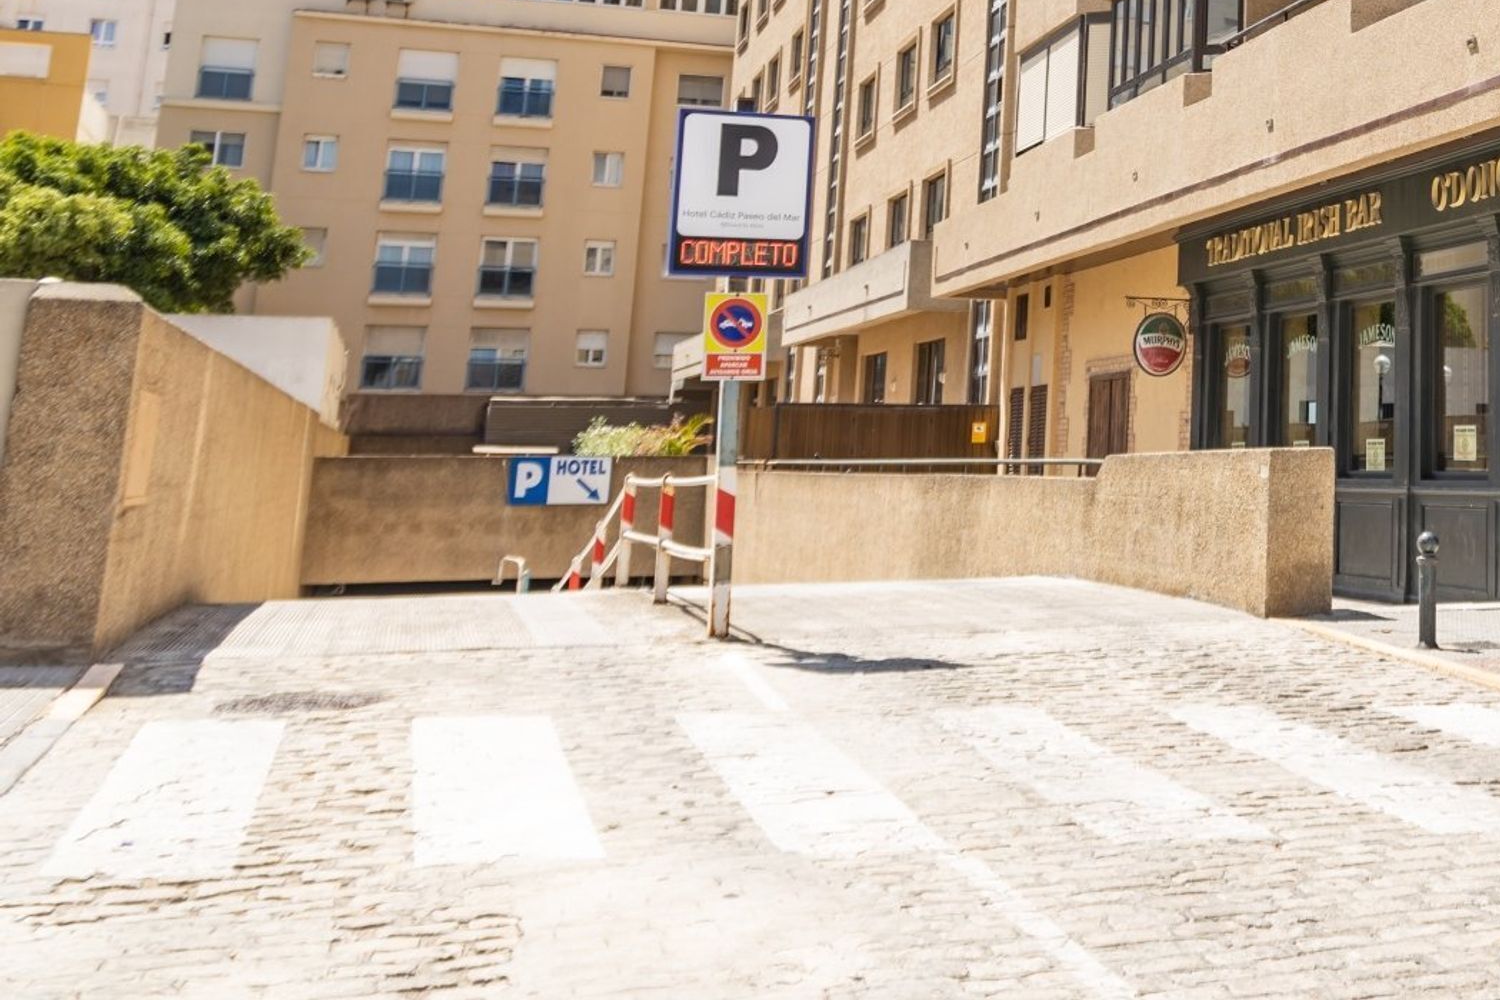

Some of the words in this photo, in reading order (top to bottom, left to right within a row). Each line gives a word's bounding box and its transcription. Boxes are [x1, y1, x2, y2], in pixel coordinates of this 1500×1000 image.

[716, 122, 779, 197] P
[682, 209, 707, 218] Hotel
[710, 209, 737, 219] Cádiz
[738, 211, 765, 221] Paseo
[767, 212, 781, 221] del
[783, 213, 801, 222] Mar
[1205, 216, 1294, 267] TRADITIONAL
[1296, 203, 1341, 246] IRISH
[1344, 191, 1383, 233] BAR
[679, 240, 799, 267] COMPLETO
[514, 461, 544, 498] P
[556, 459, 607, 475] HOTEL
